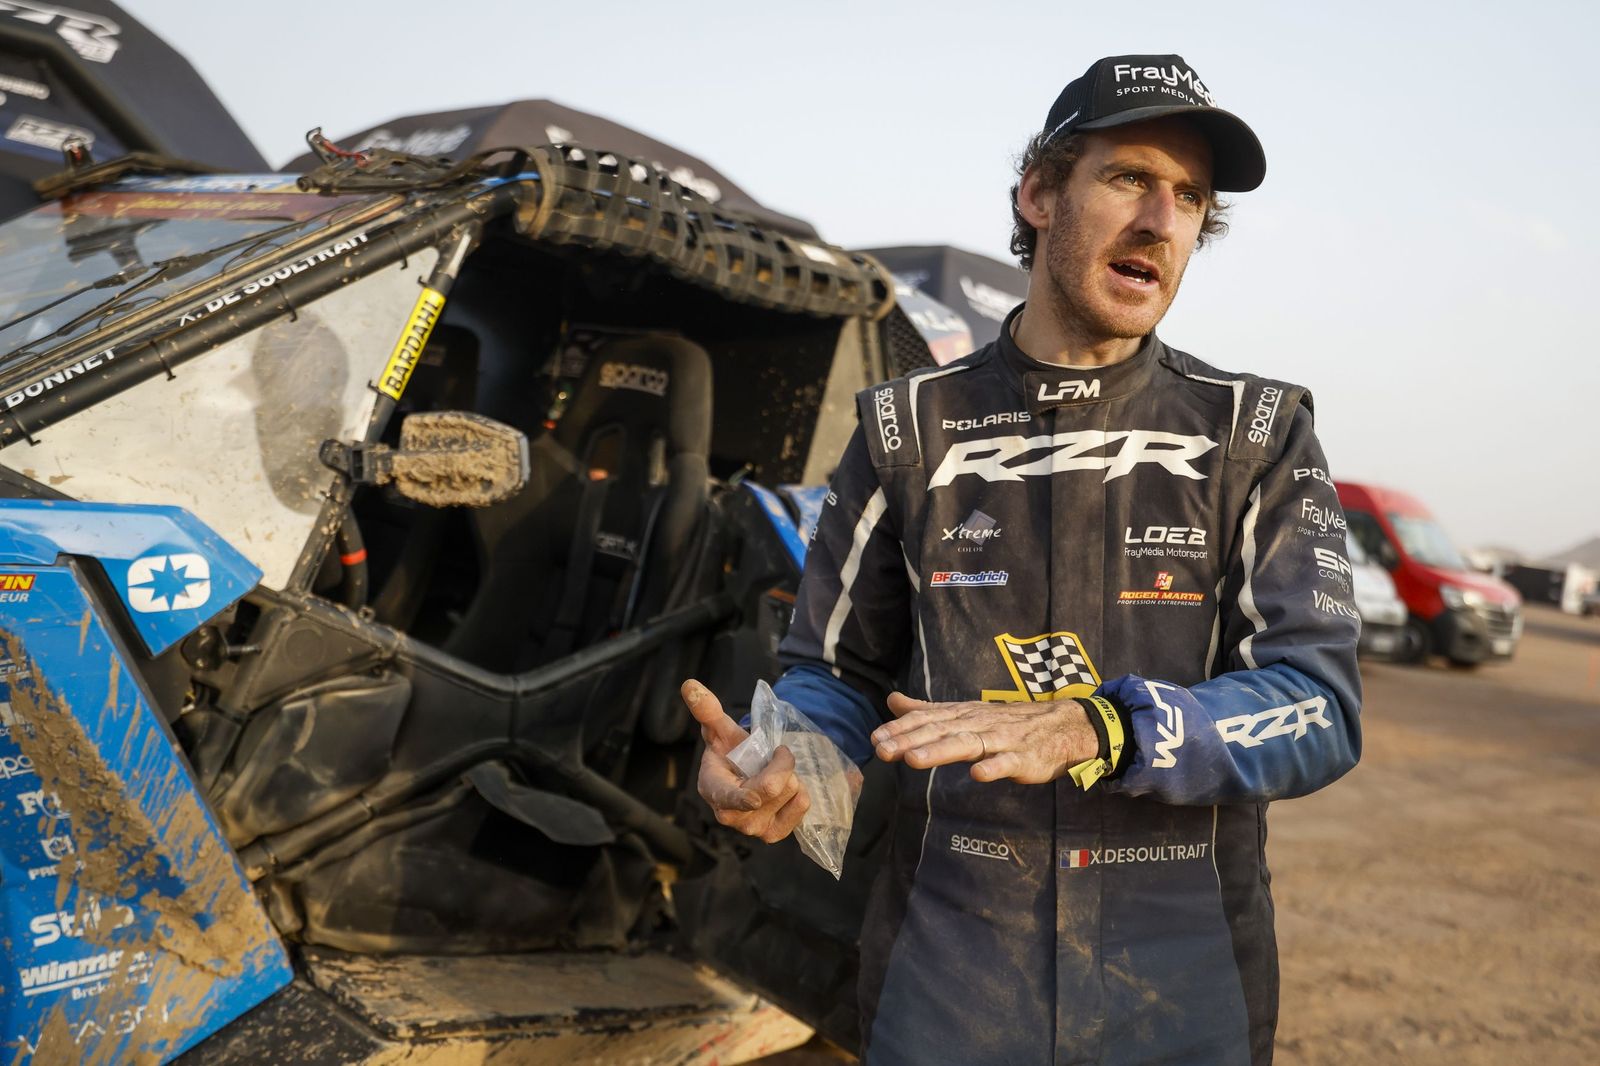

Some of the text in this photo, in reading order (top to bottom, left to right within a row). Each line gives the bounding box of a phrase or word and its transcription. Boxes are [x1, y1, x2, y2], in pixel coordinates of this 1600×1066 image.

[1116, 85, 1196, 105] SPORT MEDIA
[205, 291, 242, 314] DE
[242, 232, 369, 295] SOULTRAIT
[5, 347, 116, 408] BONNET
[1037, 378, 1101, 401] LFM
[874, 387, 902, 453] sparco
[942, 411, 1031, 431] POLARIS
[1248, 386, 1283, 447] sparco
[927, 429, 1219, 491] RZR
[1124, 547, 1208, 560] FrayMédia Motorsport
[932, 570, 1008, 583] BFGoodrich
[1120, 591, 1204, 601] ROGER MARTIN
[1215, 694, 1333, 748] RZR
[951, 834, 1009, 861] sparco
